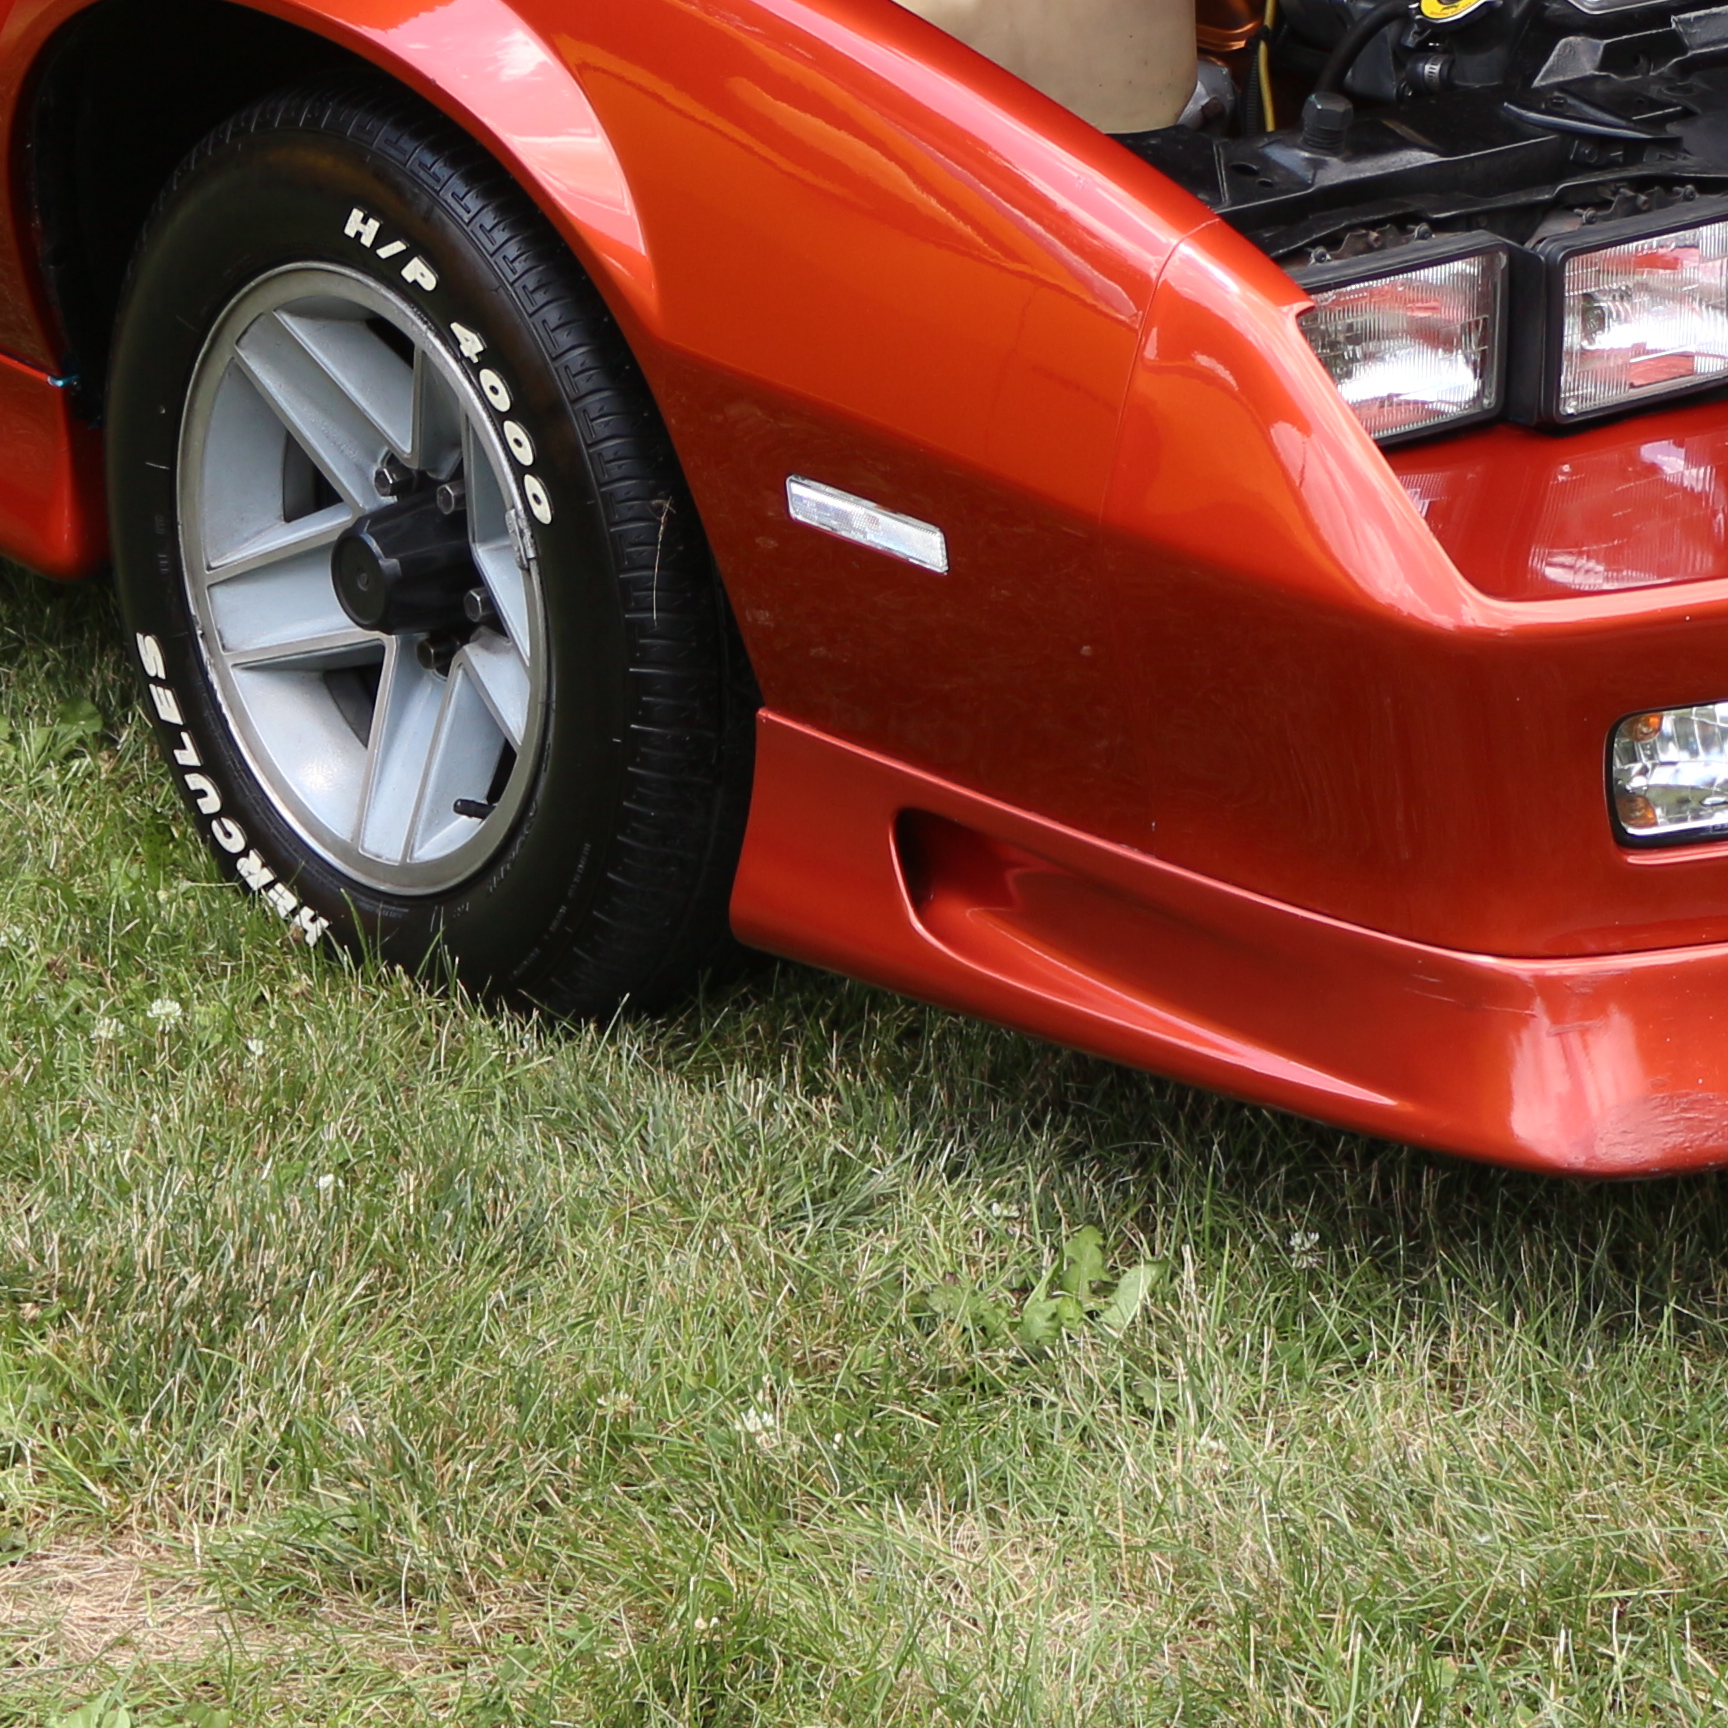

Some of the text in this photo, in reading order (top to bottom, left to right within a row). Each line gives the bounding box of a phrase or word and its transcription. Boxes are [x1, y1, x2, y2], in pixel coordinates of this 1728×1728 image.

[343, 207, 553, 526] H/P 4000
[135, 632, 332, 947] HERCULES
